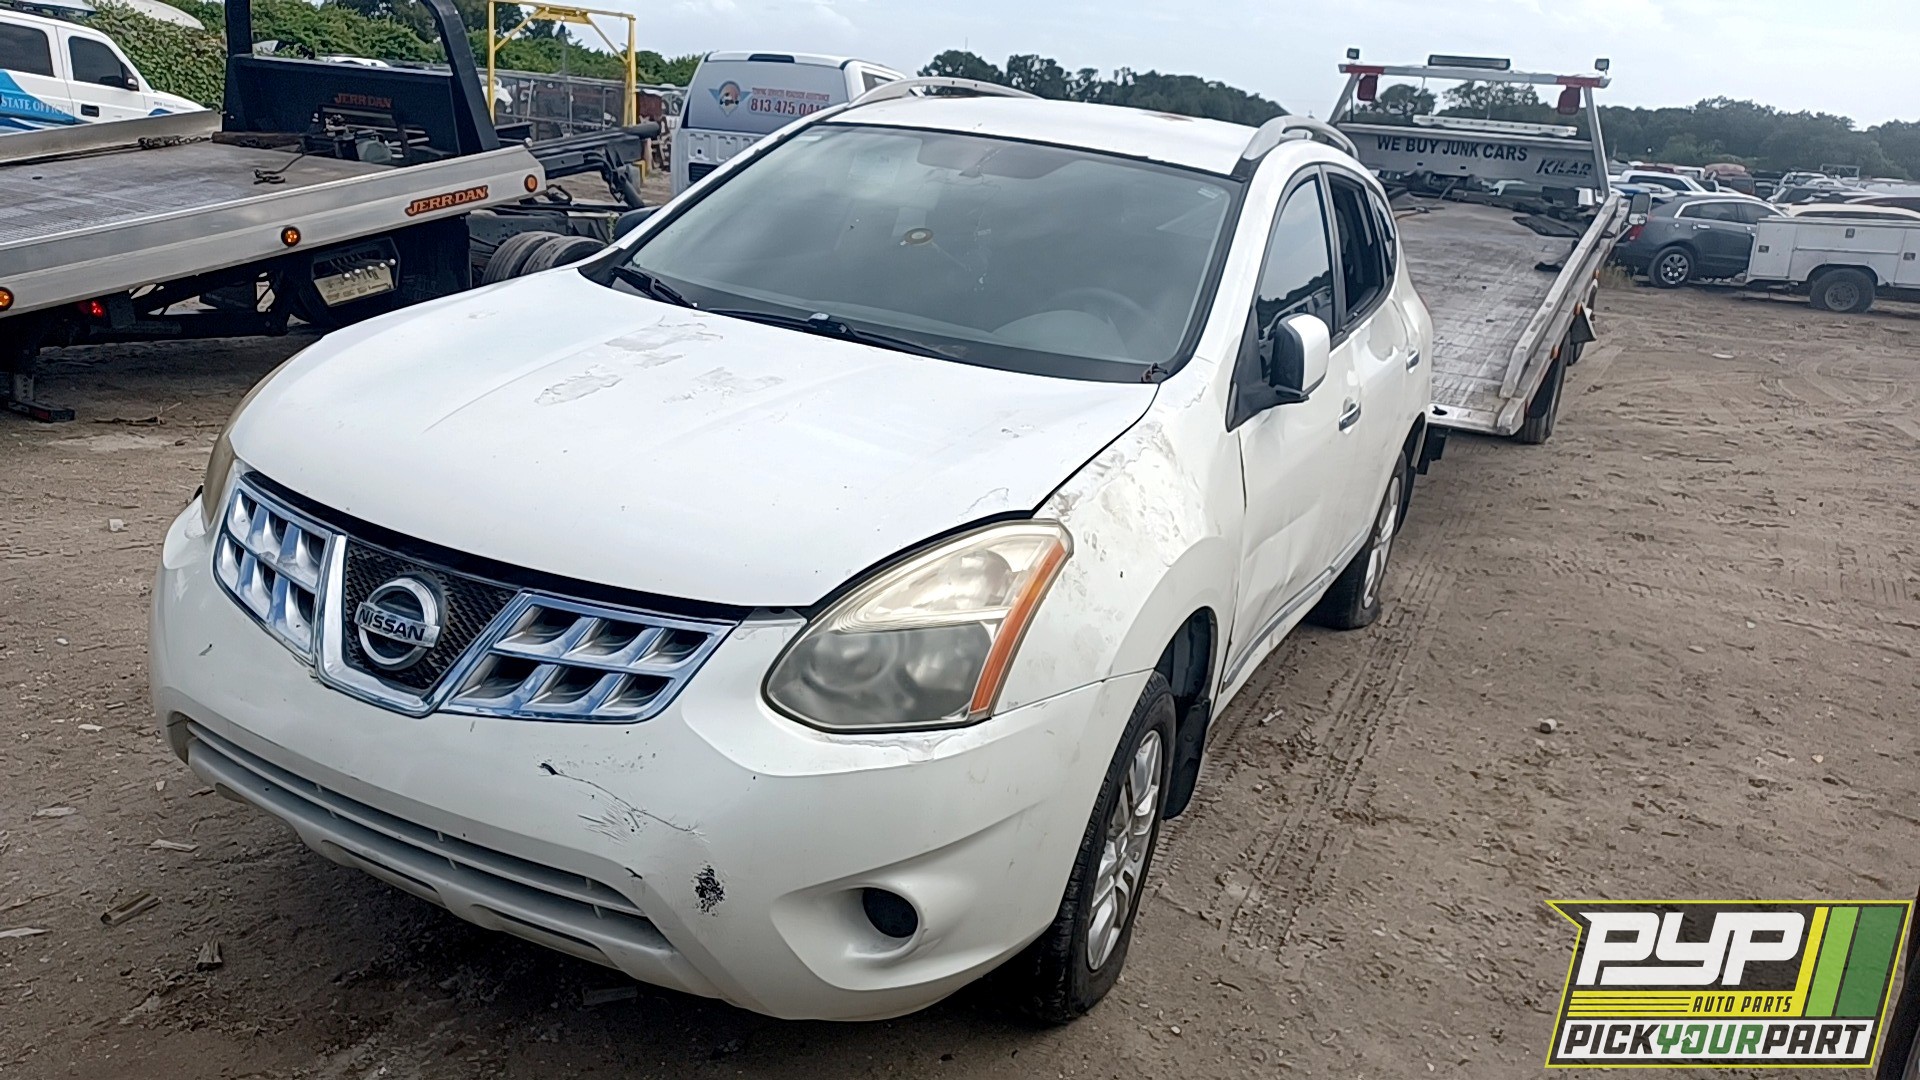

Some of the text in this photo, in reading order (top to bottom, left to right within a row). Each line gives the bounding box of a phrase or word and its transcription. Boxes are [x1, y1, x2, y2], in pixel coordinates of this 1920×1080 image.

[1377, 136, 1528, 162] WE BUY JUNK CARS
[1536, 159, 1592, 176] KILAR
[359, 608, 426, 642] NISSAN
